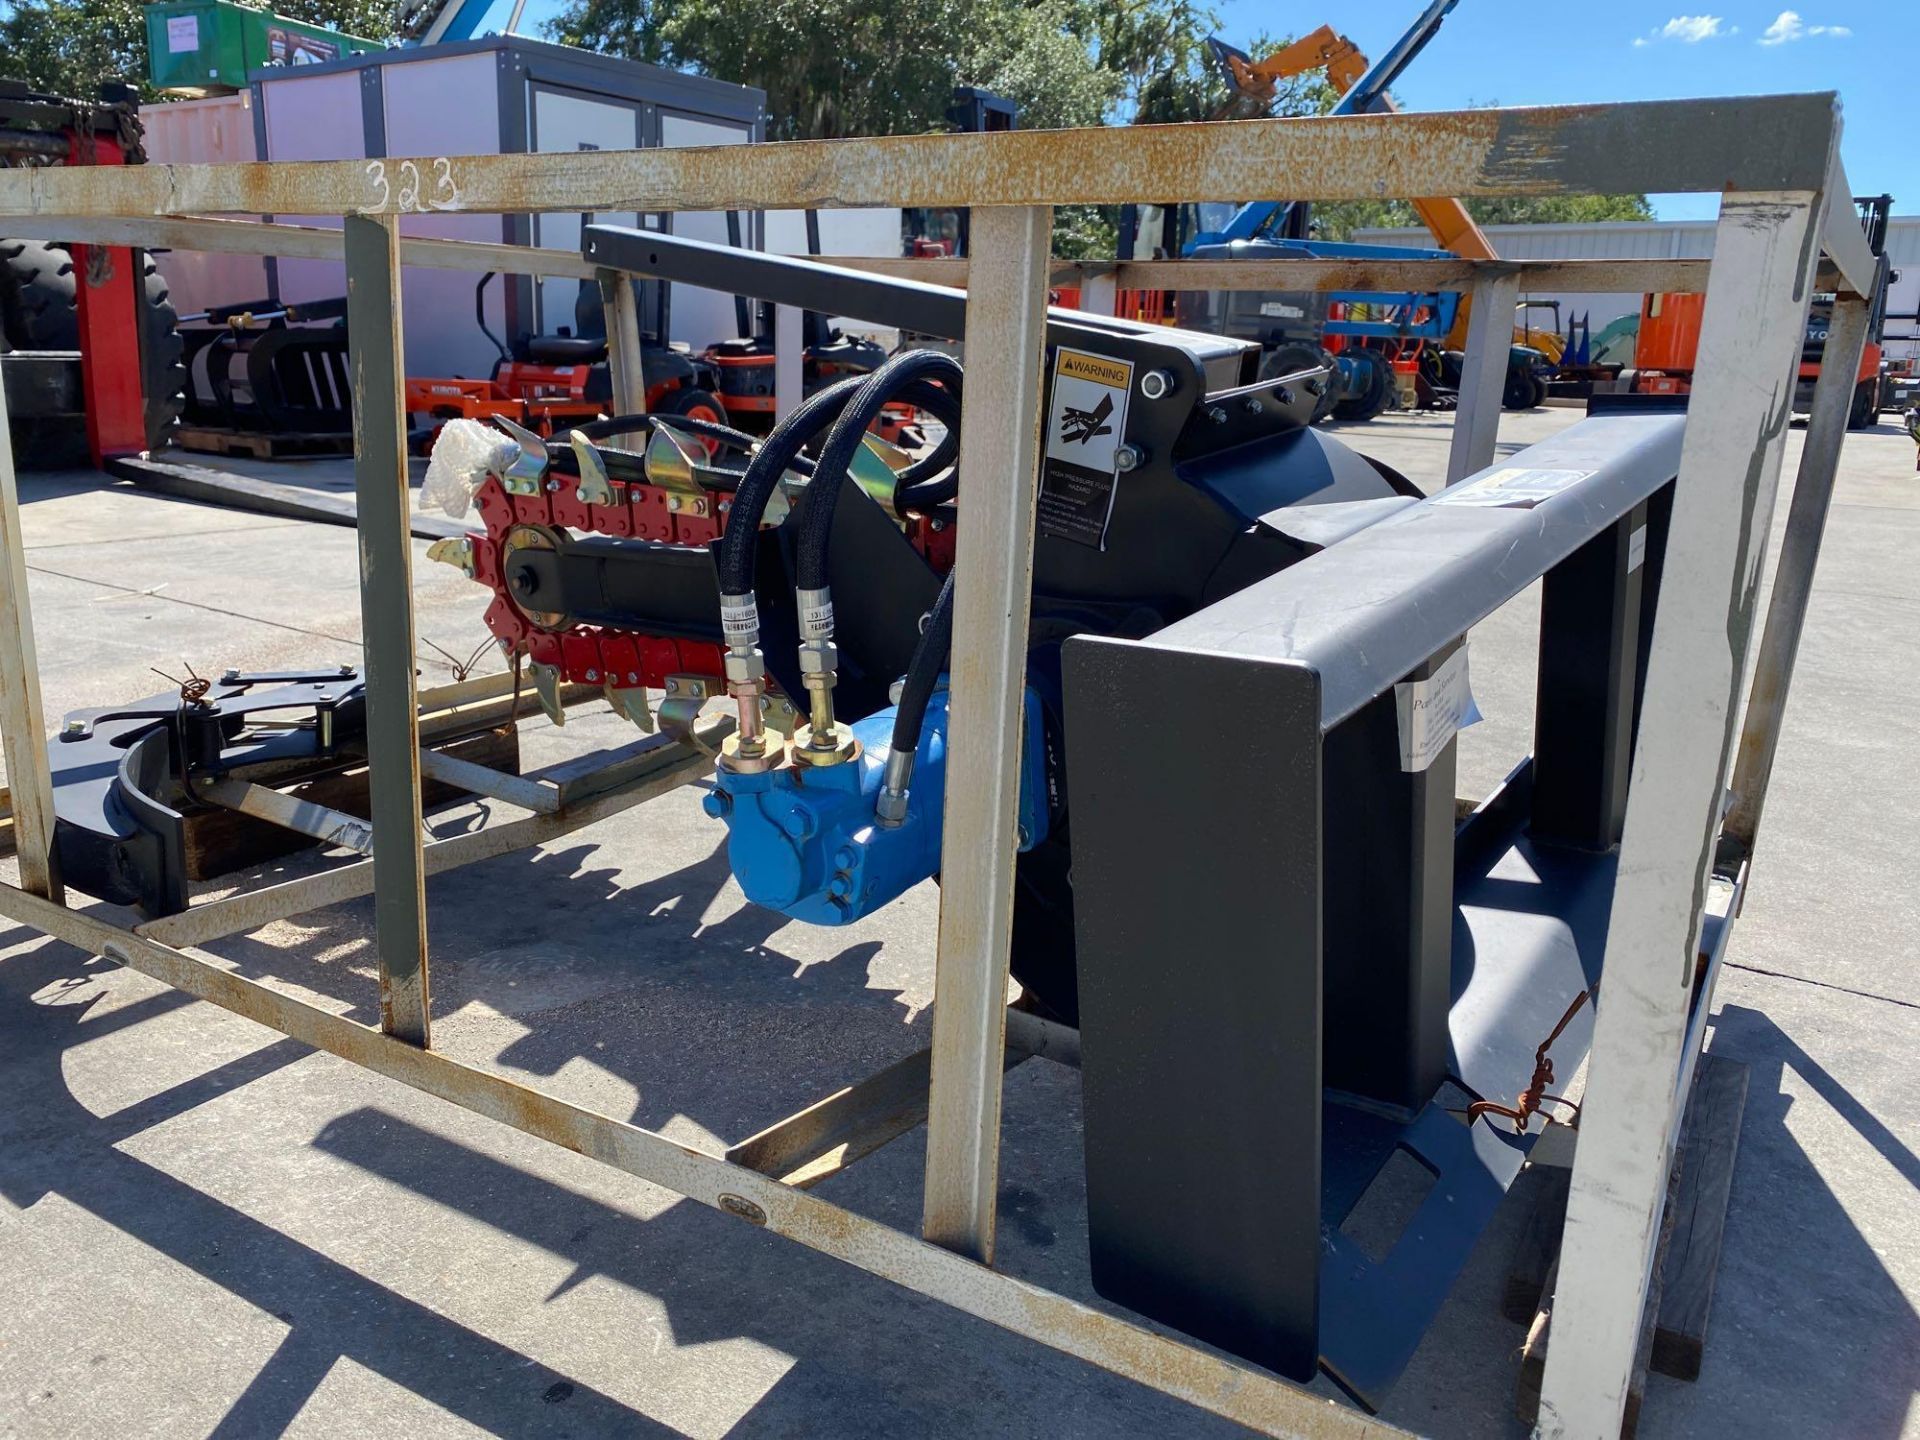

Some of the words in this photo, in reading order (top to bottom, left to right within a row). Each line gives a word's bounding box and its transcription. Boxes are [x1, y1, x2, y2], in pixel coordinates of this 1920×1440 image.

[357, 157, 459, 214] 323
[1808, 330, 1829, 340] YO
[1073, 361, 1125, 382] WARNING
